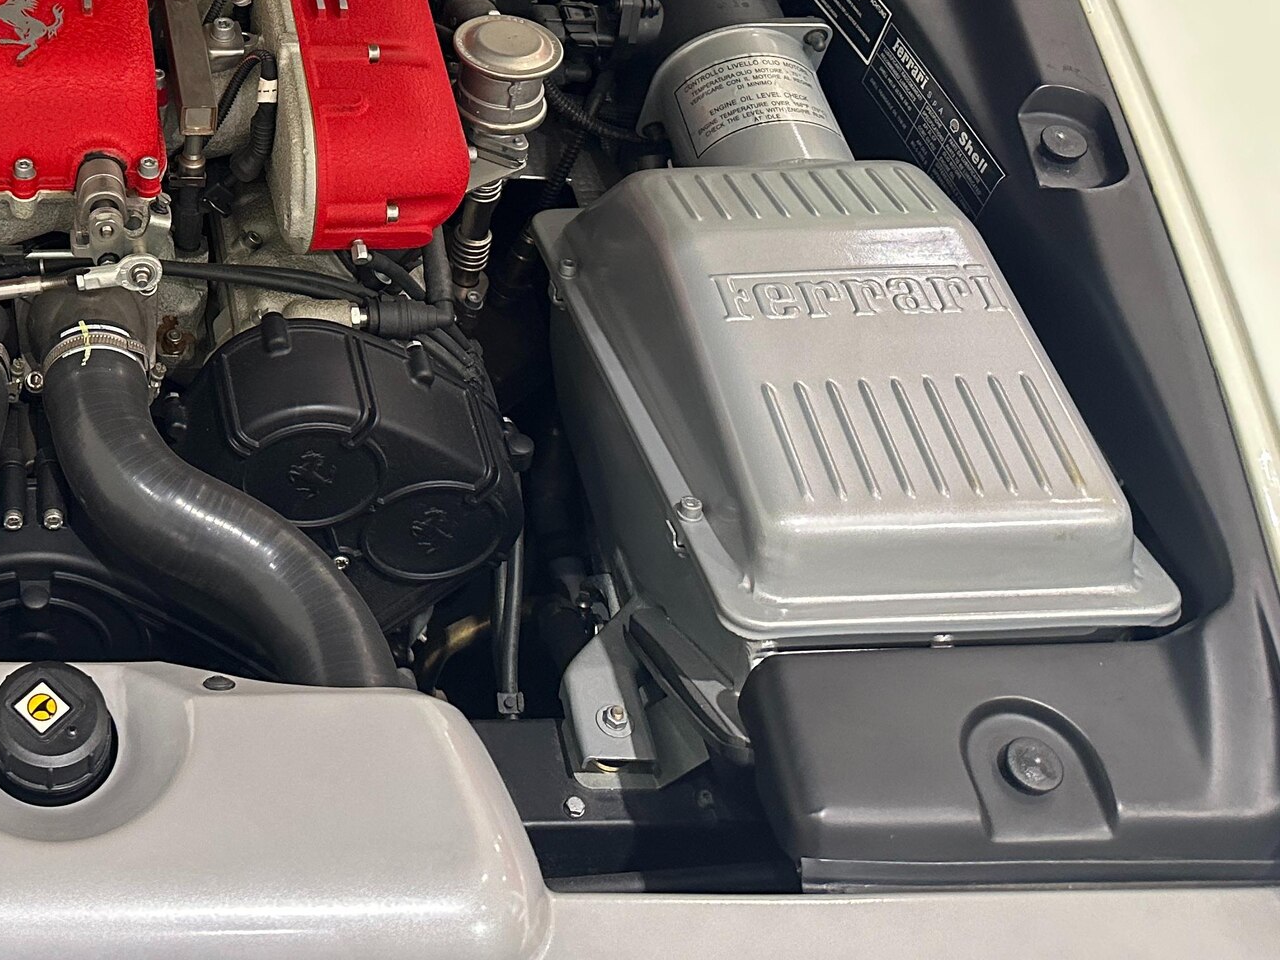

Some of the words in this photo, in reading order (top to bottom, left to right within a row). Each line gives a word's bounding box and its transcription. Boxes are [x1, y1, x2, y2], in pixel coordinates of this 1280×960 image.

[735, 69, 753, 77] OLIO
[891, 36, 930, 90] Ferrari
[684, 67, 725, 93] CONTROLLO
[726, 59, 759, 71] LIVELLO
[726, 78, 742, 87] CON
[709, 98, 738, 116] ENGINE
[739, 94, 754, 103] OIL
[755, 91, 782, 100] LEVEL
[719, 101, 769, 120] TEMPERATURE
[726, 115, 741, 124] THE
[958, 131, 988, 174] Shell
[709, 264, 1009, 322] Ferrari
